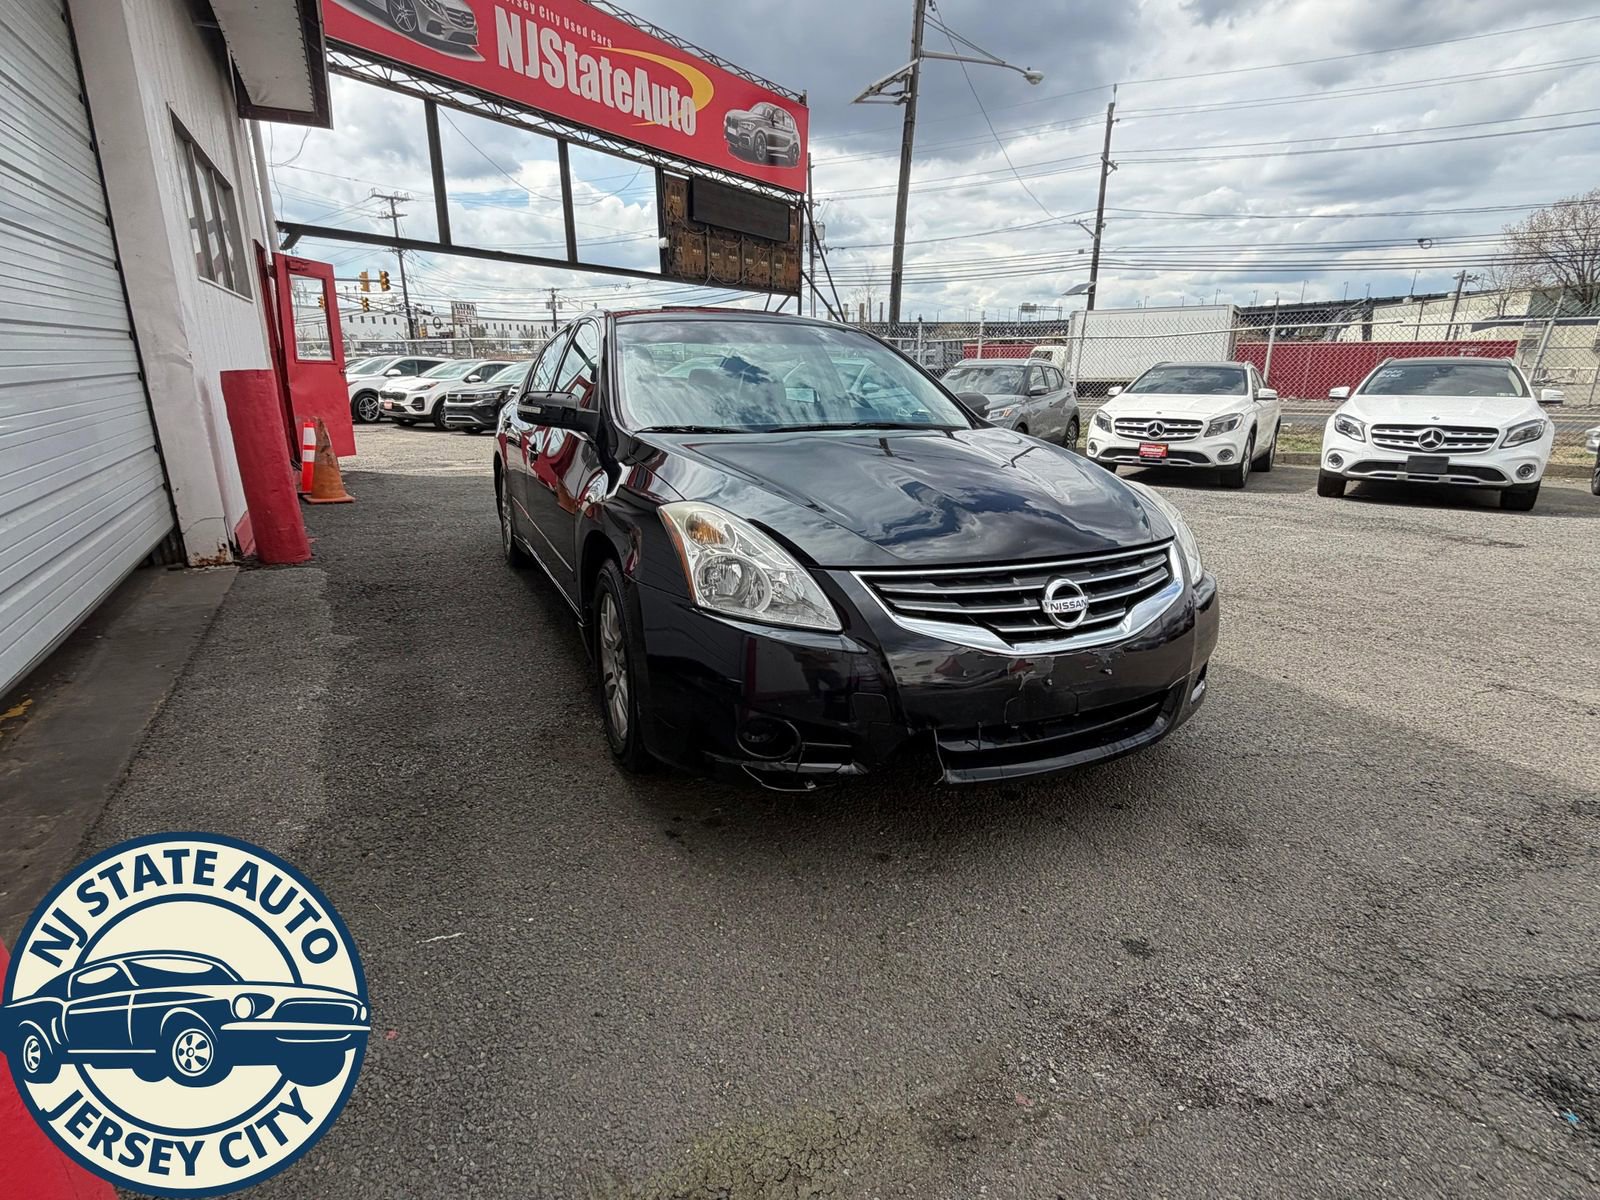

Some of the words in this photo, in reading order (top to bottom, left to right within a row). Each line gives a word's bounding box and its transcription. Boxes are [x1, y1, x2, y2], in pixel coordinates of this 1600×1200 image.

[539, 5, 560, 26] City
[563, 17, 587, 38] Used
[590, 29, 612, 49] Cars
[495, 5, 697, 136] NJStateAuto
[455, 303, 475, 311] ULTRA
[1050, 600, 1088, 611] NISSAN
